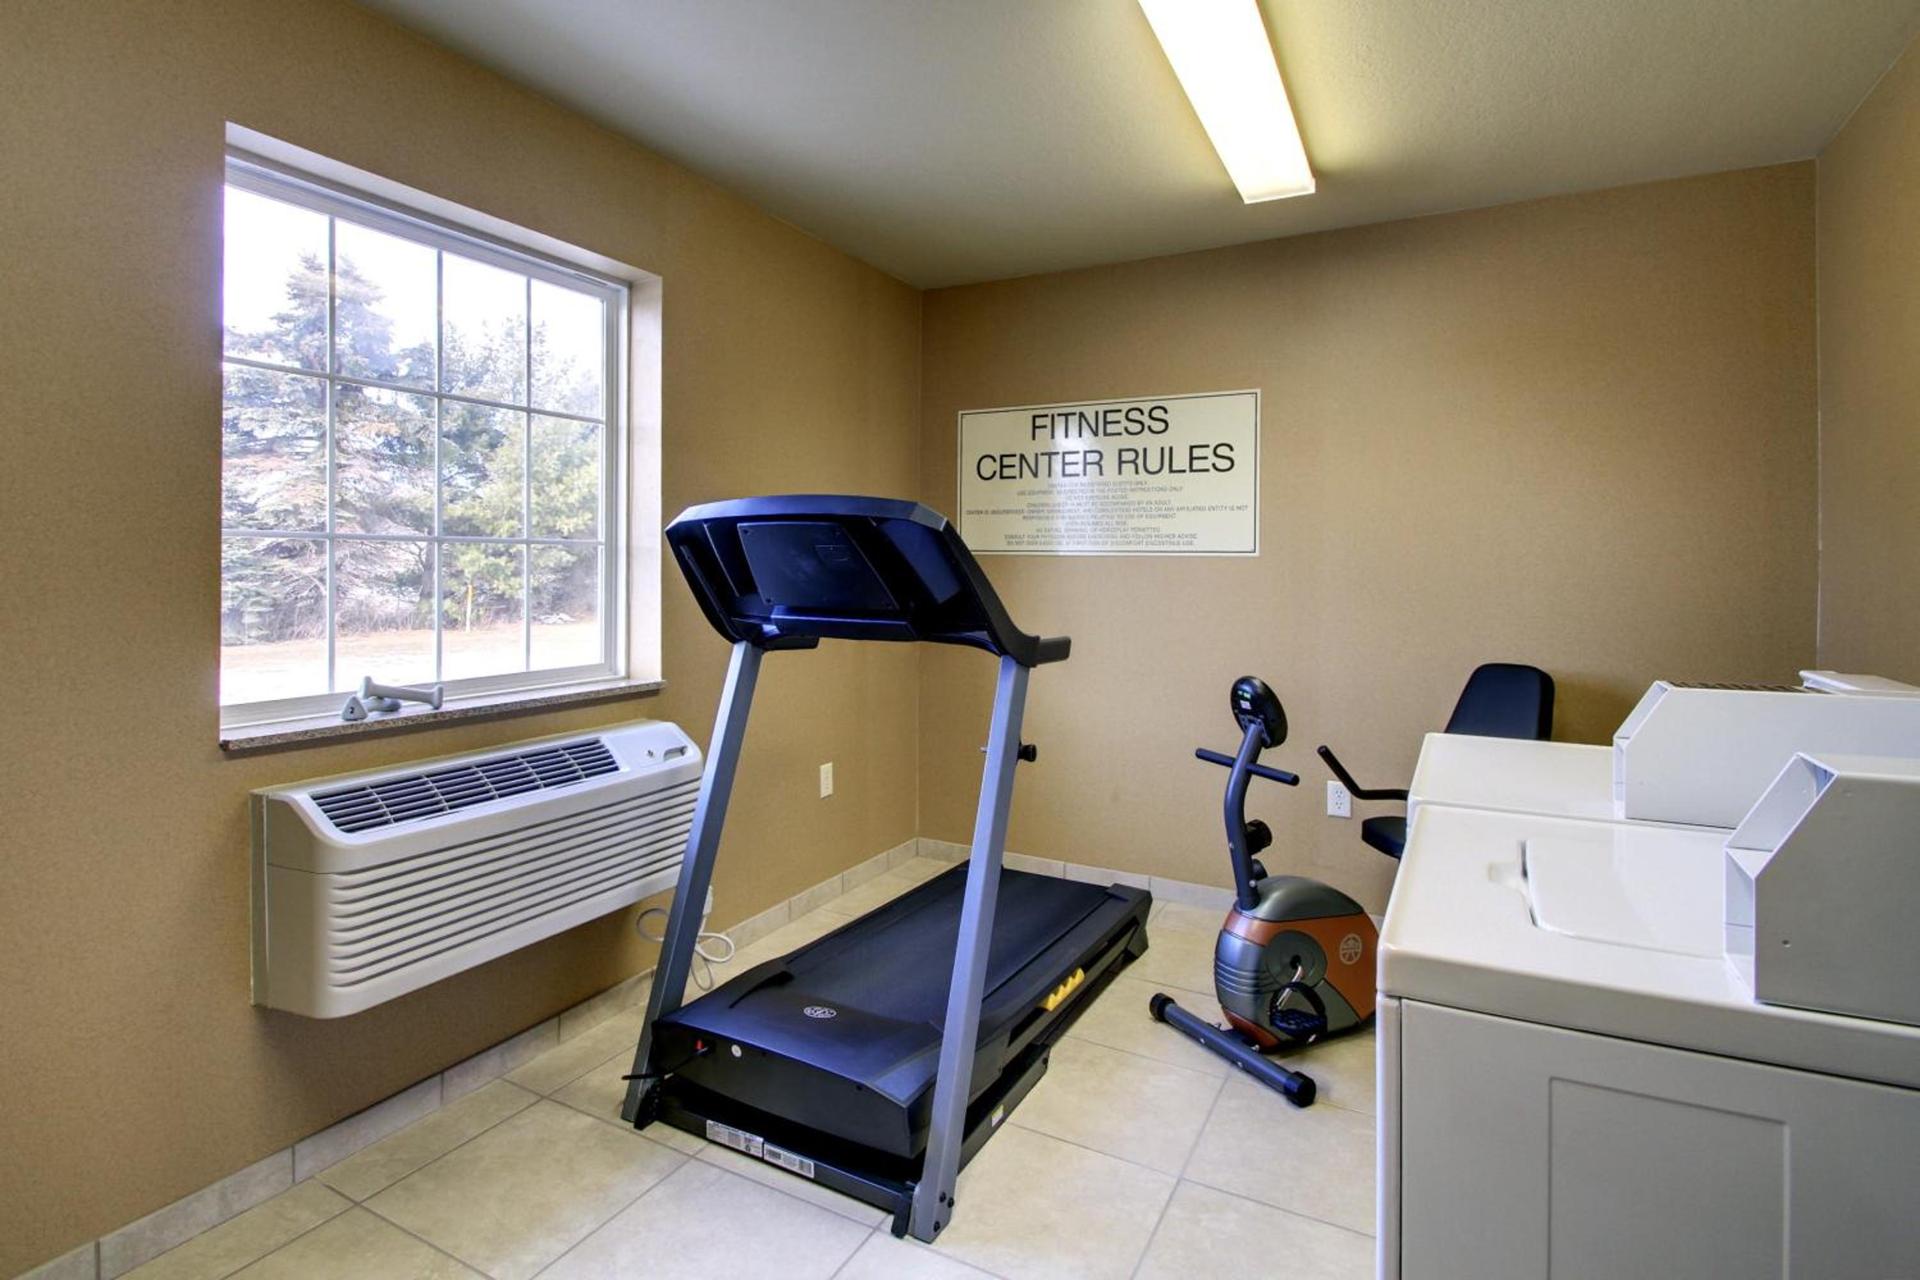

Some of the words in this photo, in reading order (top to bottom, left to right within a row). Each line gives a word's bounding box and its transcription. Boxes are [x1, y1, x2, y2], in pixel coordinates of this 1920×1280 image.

[1031, 405, 1169, 441] FITNESS
[976, 450, 1104, 481] CENTER
[1118, 443, 1235, 475] RULES
